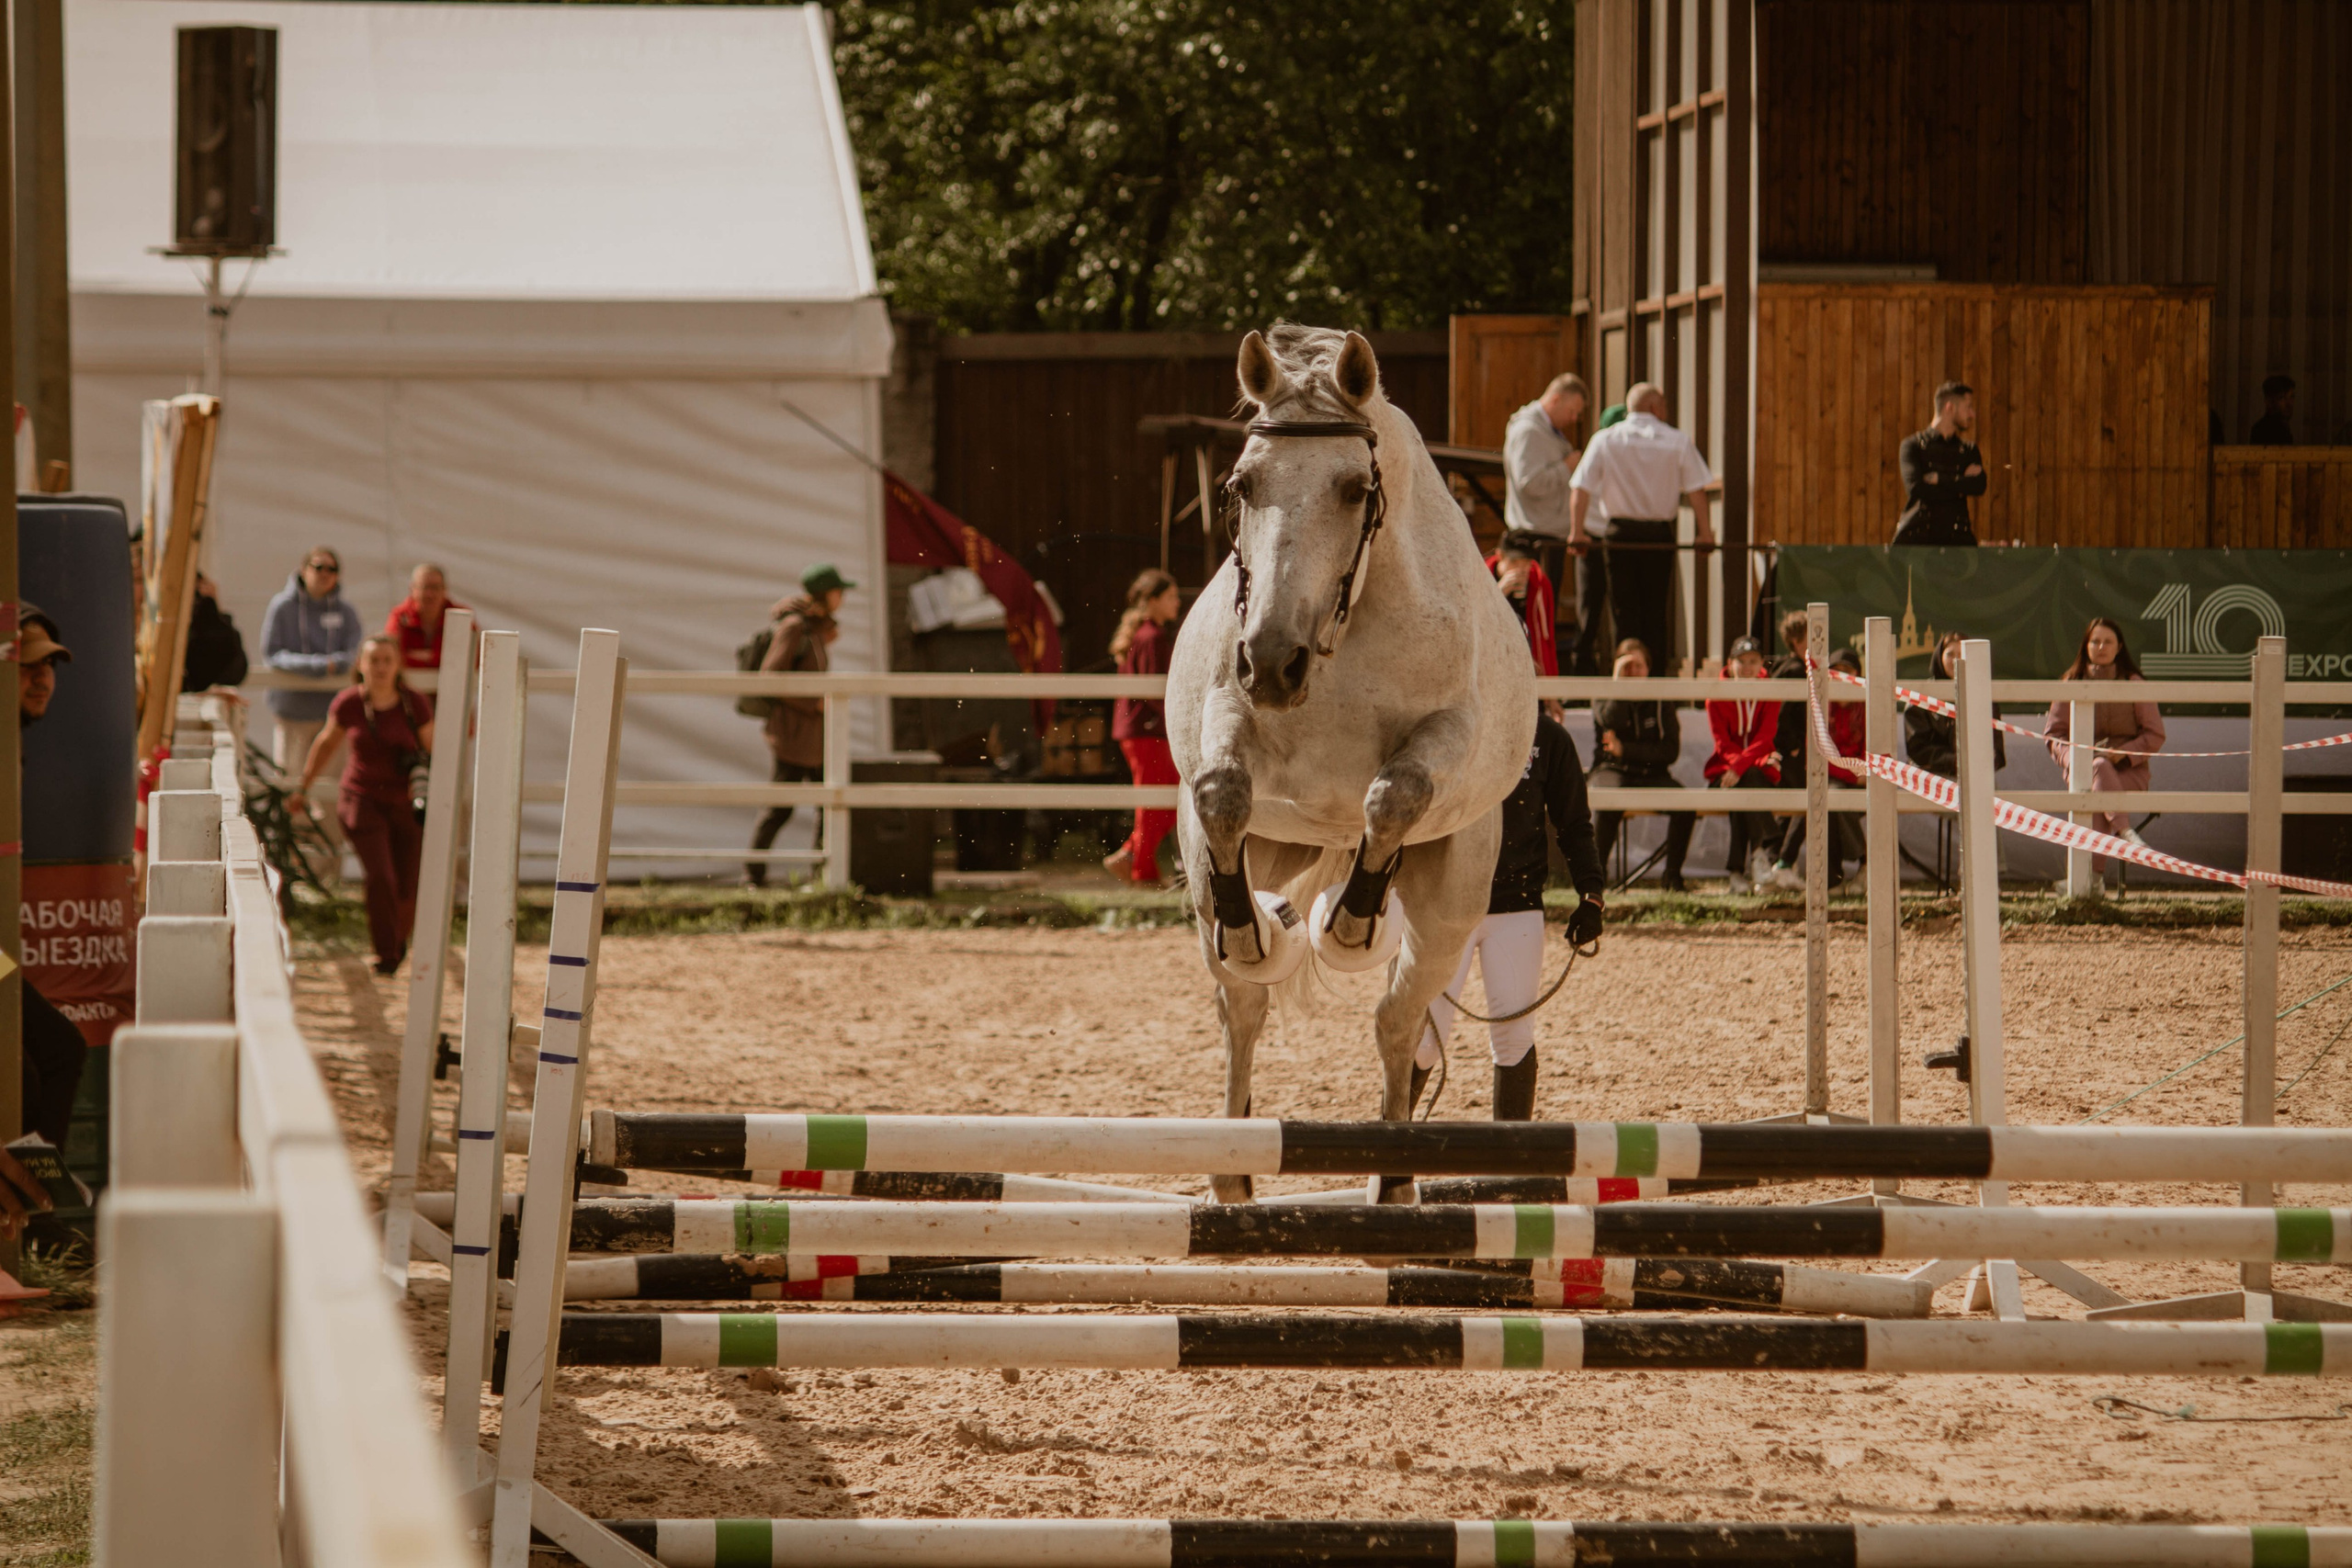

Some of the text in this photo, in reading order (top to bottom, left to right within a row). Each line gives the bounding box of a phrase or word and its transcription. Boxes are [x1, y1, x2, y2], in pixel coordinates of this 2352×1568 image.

[2140, 583, 2286, 677] 10
[19, 898, 123, 930] АБОЧАЯ
[20, 934, 129, 969] ЫЕЗДКА
